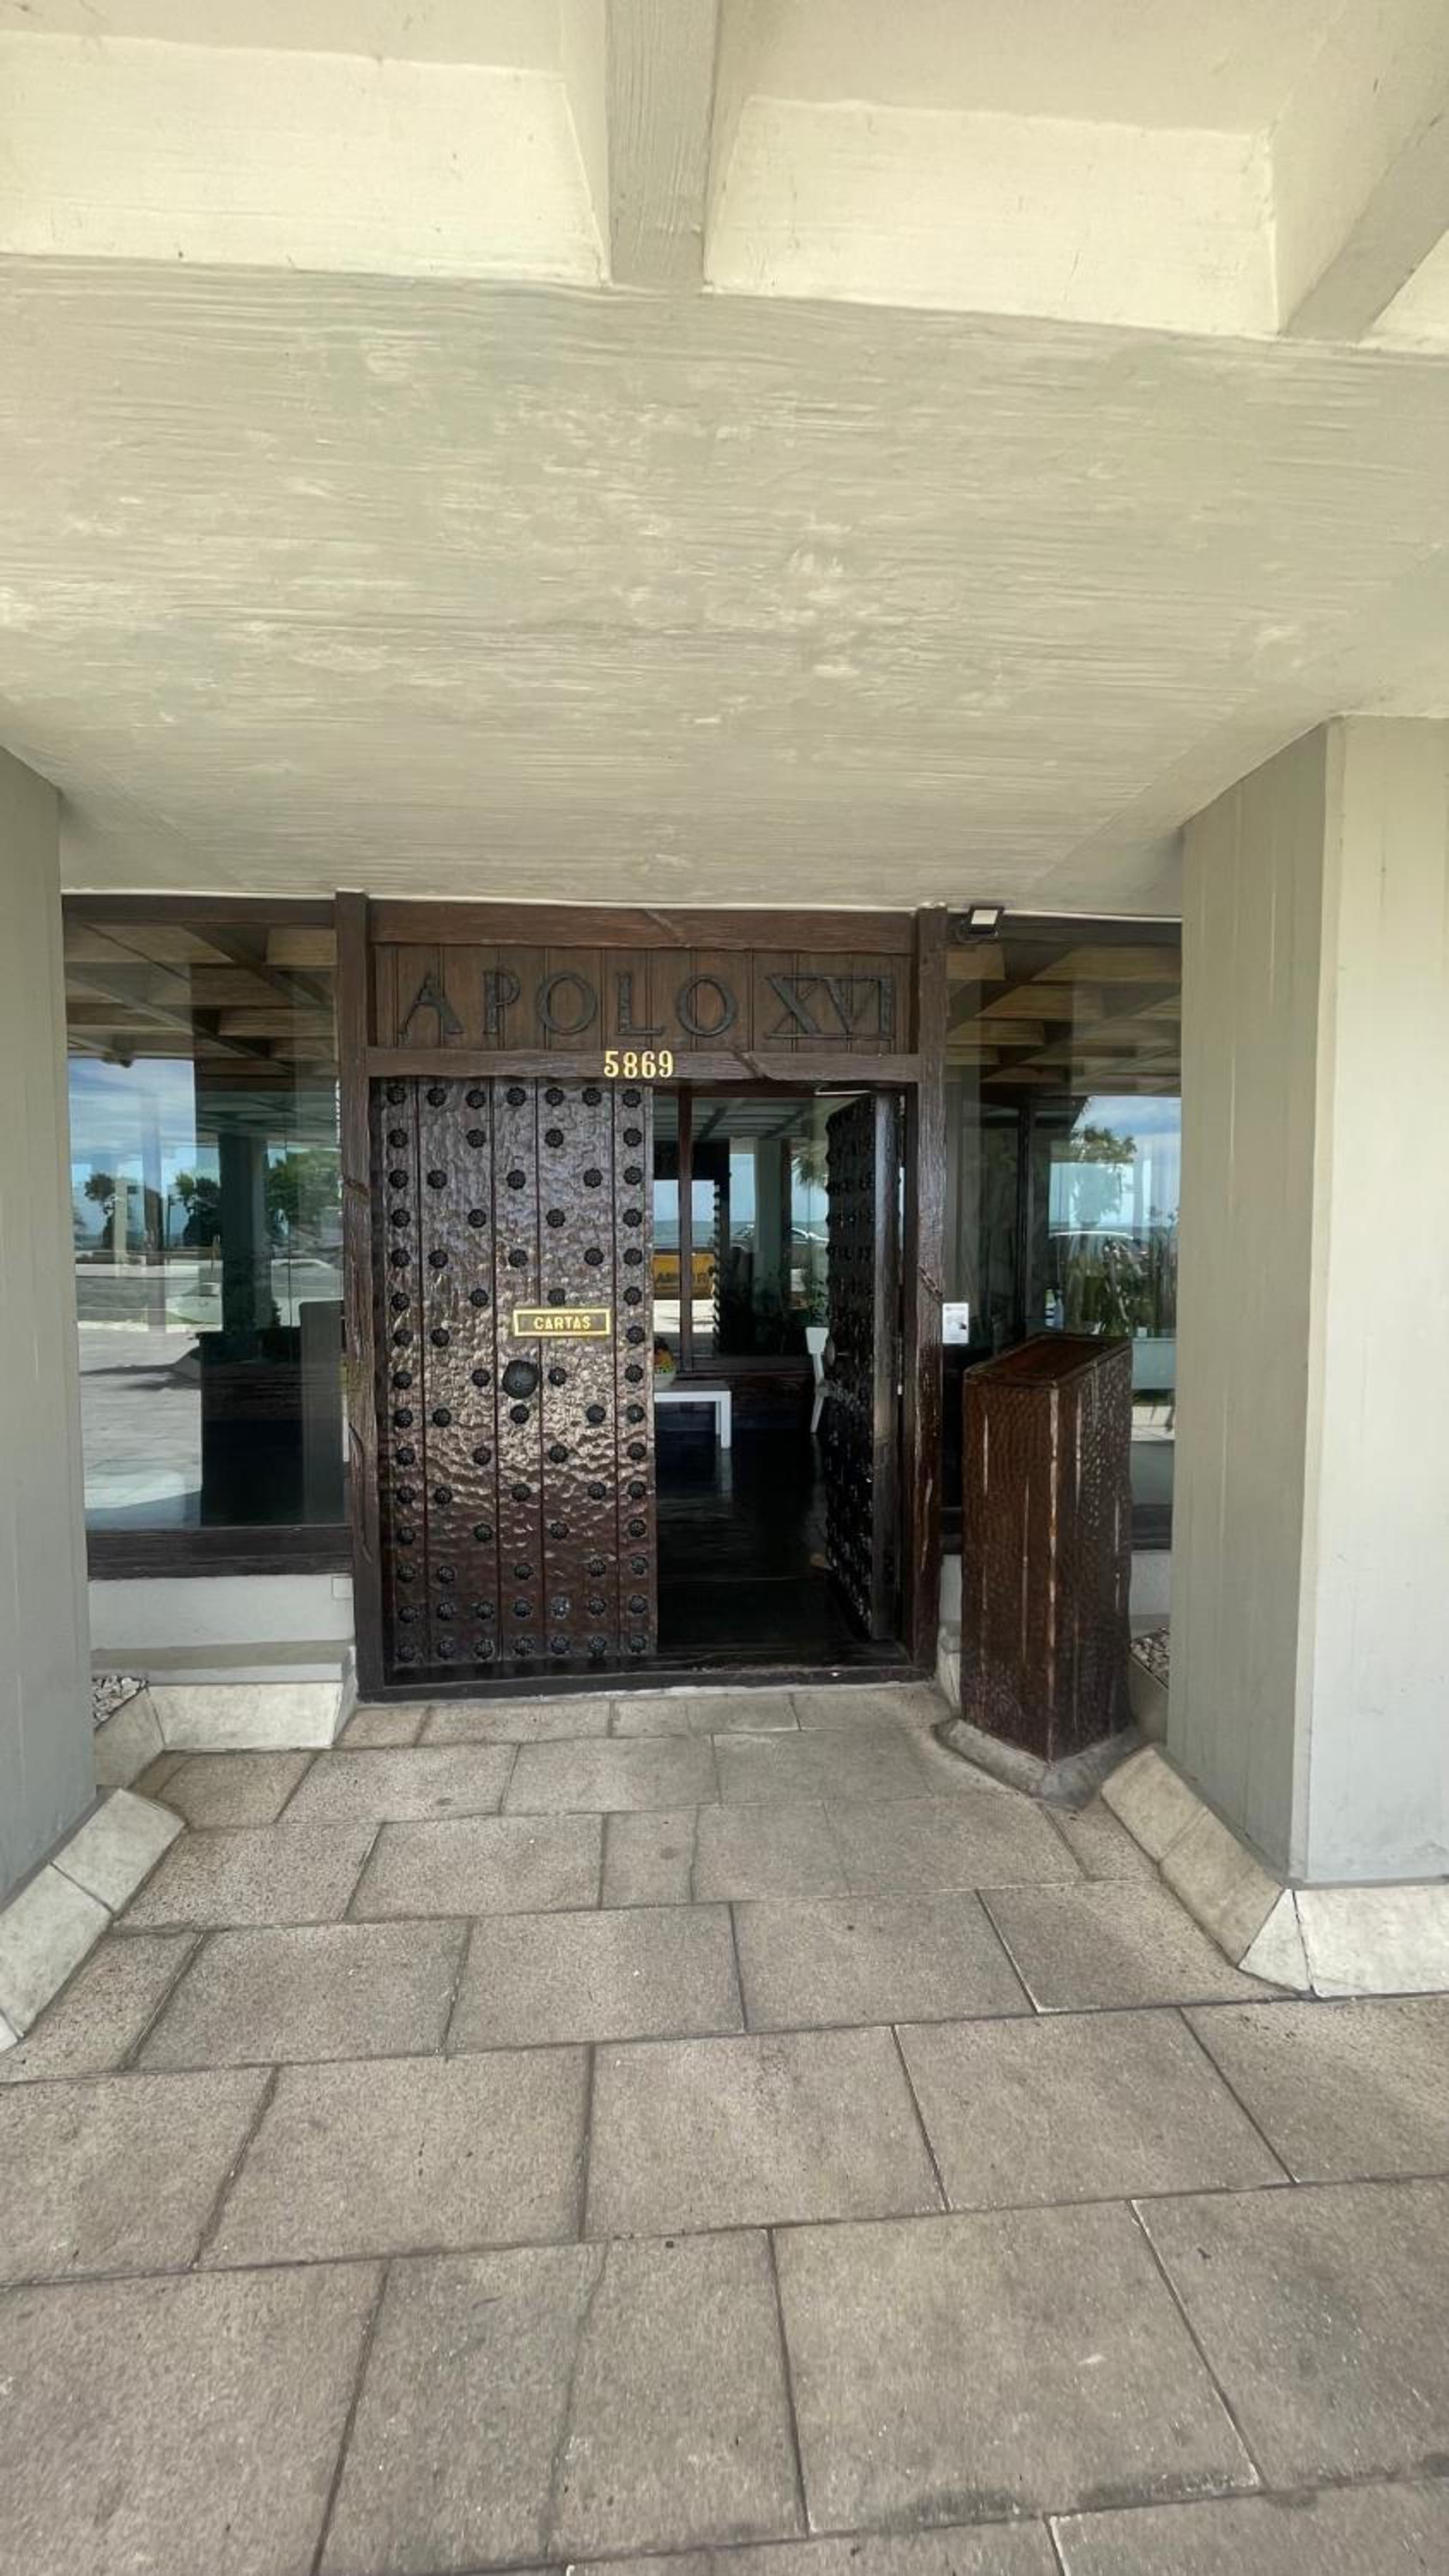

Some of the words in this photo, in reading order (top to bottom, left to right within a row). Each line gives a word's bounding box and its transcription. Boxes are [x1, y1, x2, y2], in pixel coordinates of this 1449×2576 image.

[397, 969, 737, 1037] APOLO
[765, 974, 894, 1039] XVI
[603, 1050, 673, 1078] 5869
[533, 1315, 592, 1330] CARTAS
